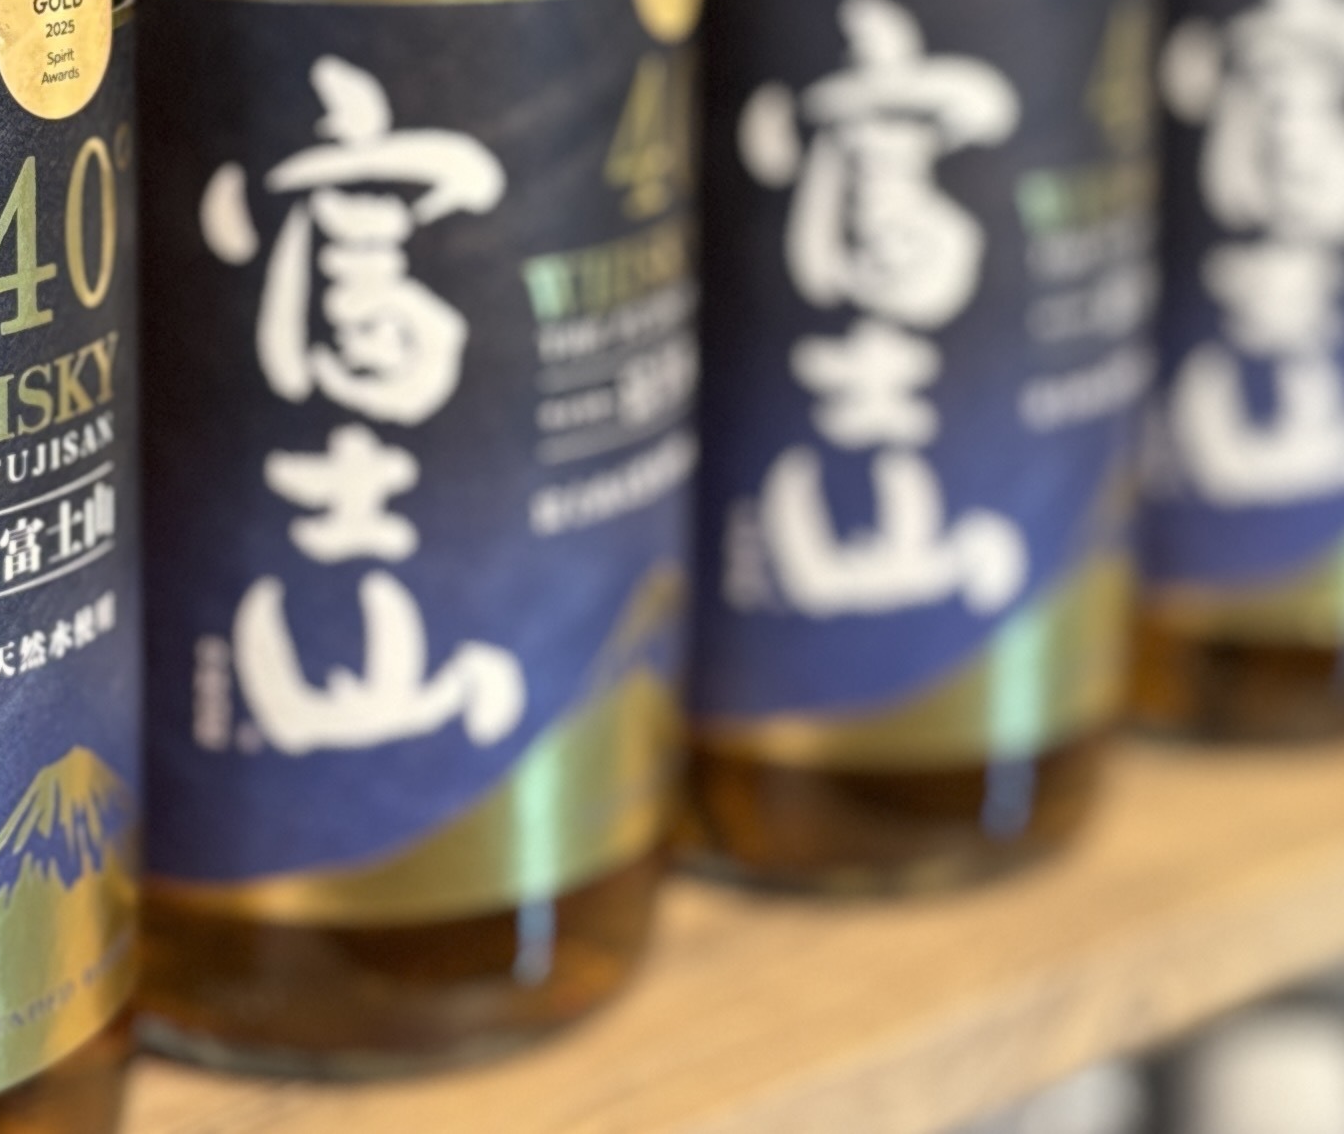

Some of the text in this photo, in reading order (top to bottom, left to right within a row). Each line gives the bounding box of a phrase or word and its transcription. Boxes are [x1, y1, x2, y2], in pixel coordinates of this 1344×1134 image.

[45, 19, 76, 39] 2025
[46, 48, 75, 68] Spirit
[40, 66, 81, 86] Awards
[200, 55, 528, 755] 富士山
